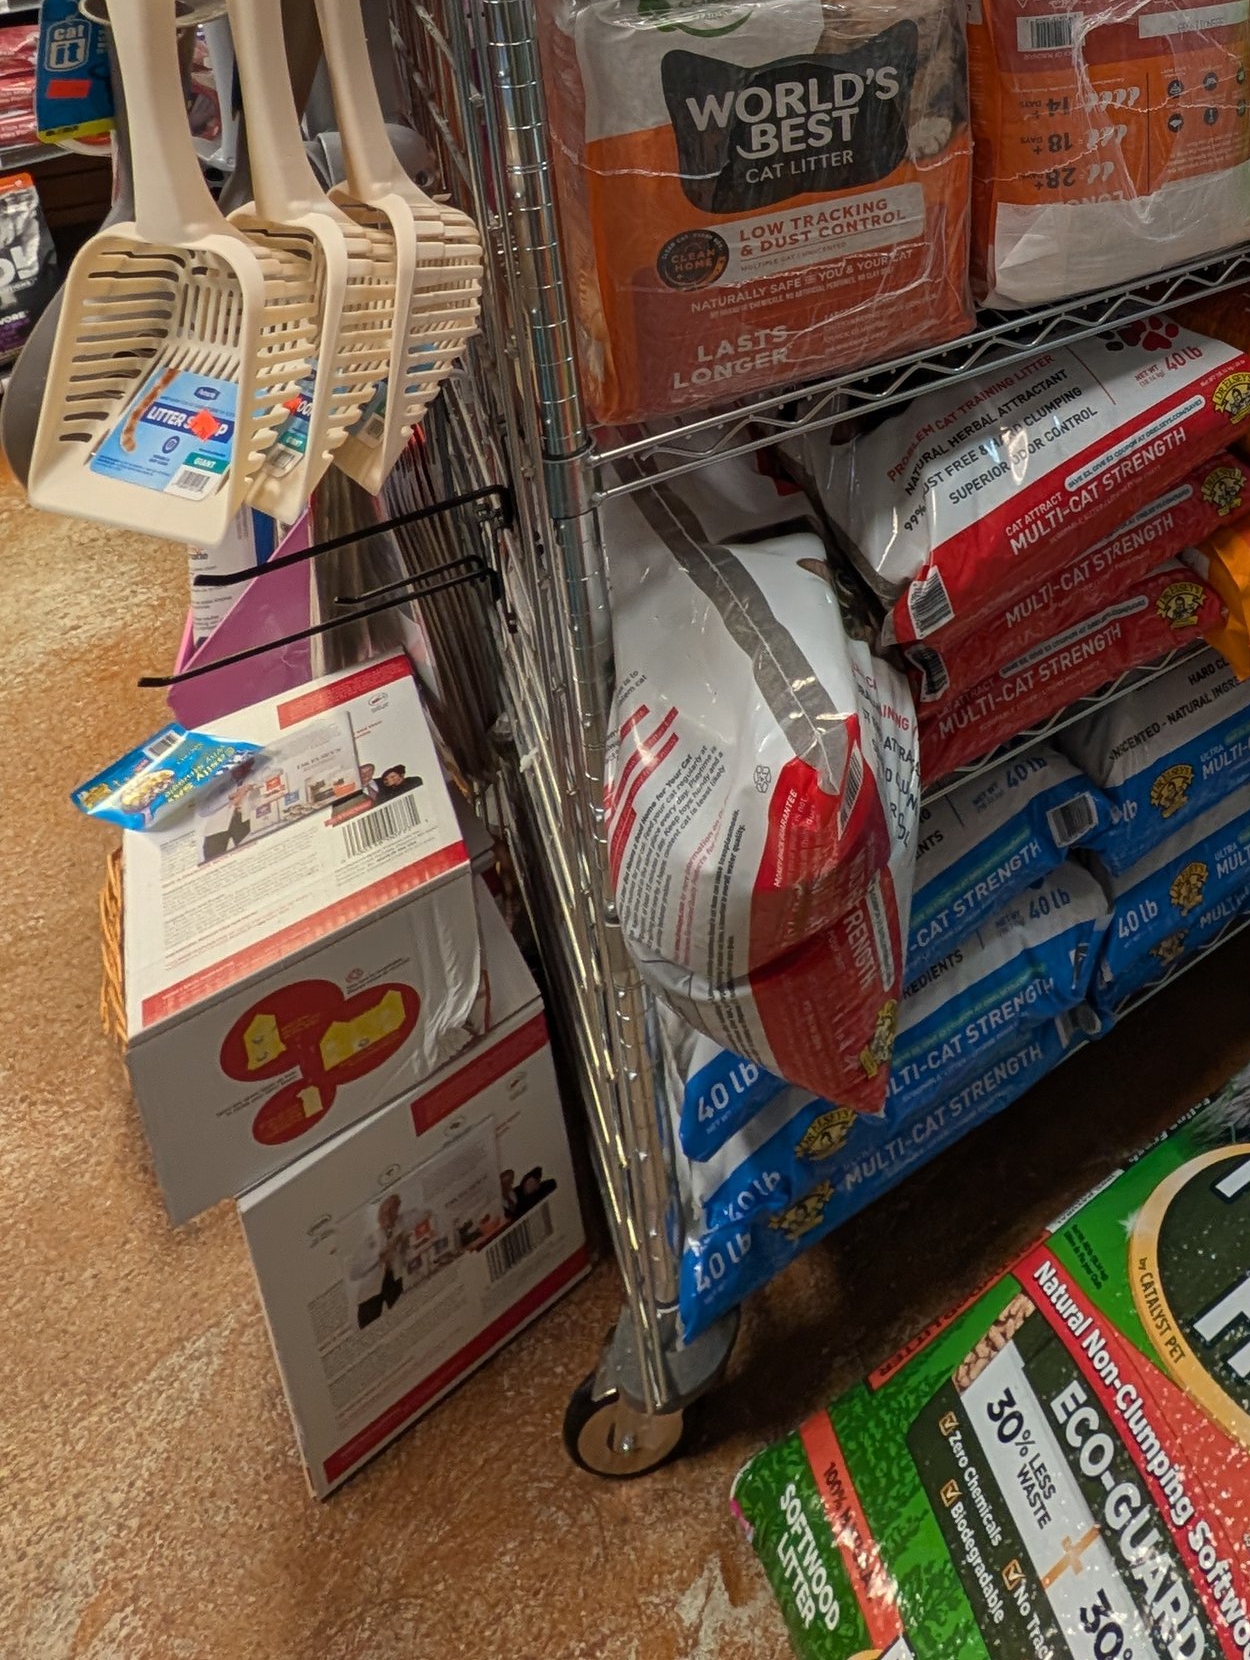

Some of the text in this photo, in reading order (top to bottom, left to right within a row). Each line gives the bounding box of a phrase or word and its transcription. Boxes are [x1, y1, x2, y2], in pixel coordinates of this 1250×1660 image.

[52, 24, 87, 42] cat
[53, 40, 87, 68] it
[686, 67, 898, 131] WORLD'S
[736, 107, 859, 159] BEST
[745, 150, 853, 184] CAT LITTER
[739, 198, 888, 242] LOW TRACKING
[760, 210, 905, 252] DUST CONTROL
[671, 249, 715, 264] CLEAN
[675, 258, 712, 272] HOME
[691, 255, 890, 314] NATURALLY SAFE YOU YOUR
[673, 347, 789, 390] LONGER
[698, 325, 787, 362] LASTS
[1165, 345, 1204, 372] 40 lb
[146, 407, 183, 430] LITTER
[935, 410, 958, 432] CAT
[959, 374, 1016, 417] TRAINING
[1013, 355, 1056, 388] LITTER
[905, 369, 1069, 497] NATURAL HERBAL ATTRACTANT
[949, 405, 1098, 506] SUPERIOR CONTROL
[194, 456, 217, 470] GIANT
[903, 386, 1083, 533] 99% FREE CLUMPING
[1005, 492, 1064, 537] CAT ATTRACT
[1009, 426, 1188, 557] MULTI-CAT STRENGTH
[1005, 513, 1175, 629] MULTI-CAT STRENGTH
[938, 623, 1123, 741] MULTI-CAT STRENGTH
[1166, 695, 1212, 726] NATURAL
[666, 769, 681, 787] Your
[682, 754, 692, 769] Cat
[677, 755, 701, 790] regularly
[1200, 744, 1224, 761] ULTRA
[954, 840, 1043, 920] STRENGTH
[1118, 899, 1158, 939] 40 lb
[698, 1060, 760, 1124] 40 lb
[1143, 1271, 1186, 1366] CATALYST PET
[1033, 1261, 1093, 1340] Natural
[1080, 1330, 1197, 1528] Non-Clumping
[986, 1386, 1057, 1502] 30% LESS
[822, 1461, 846, 1511] 100%
[947, 1433, 1003, 1549] Zero Chemicals
[1016, 1464, 1052, 1531] WASTE
[777, 1531, 816, 1631] LITTER
[779, 1482, 841, 1632] SOFTWOOD
[950, 1502, 1006, 1626] Biodegradable
[1013, 1583, 1031, 1617] No
